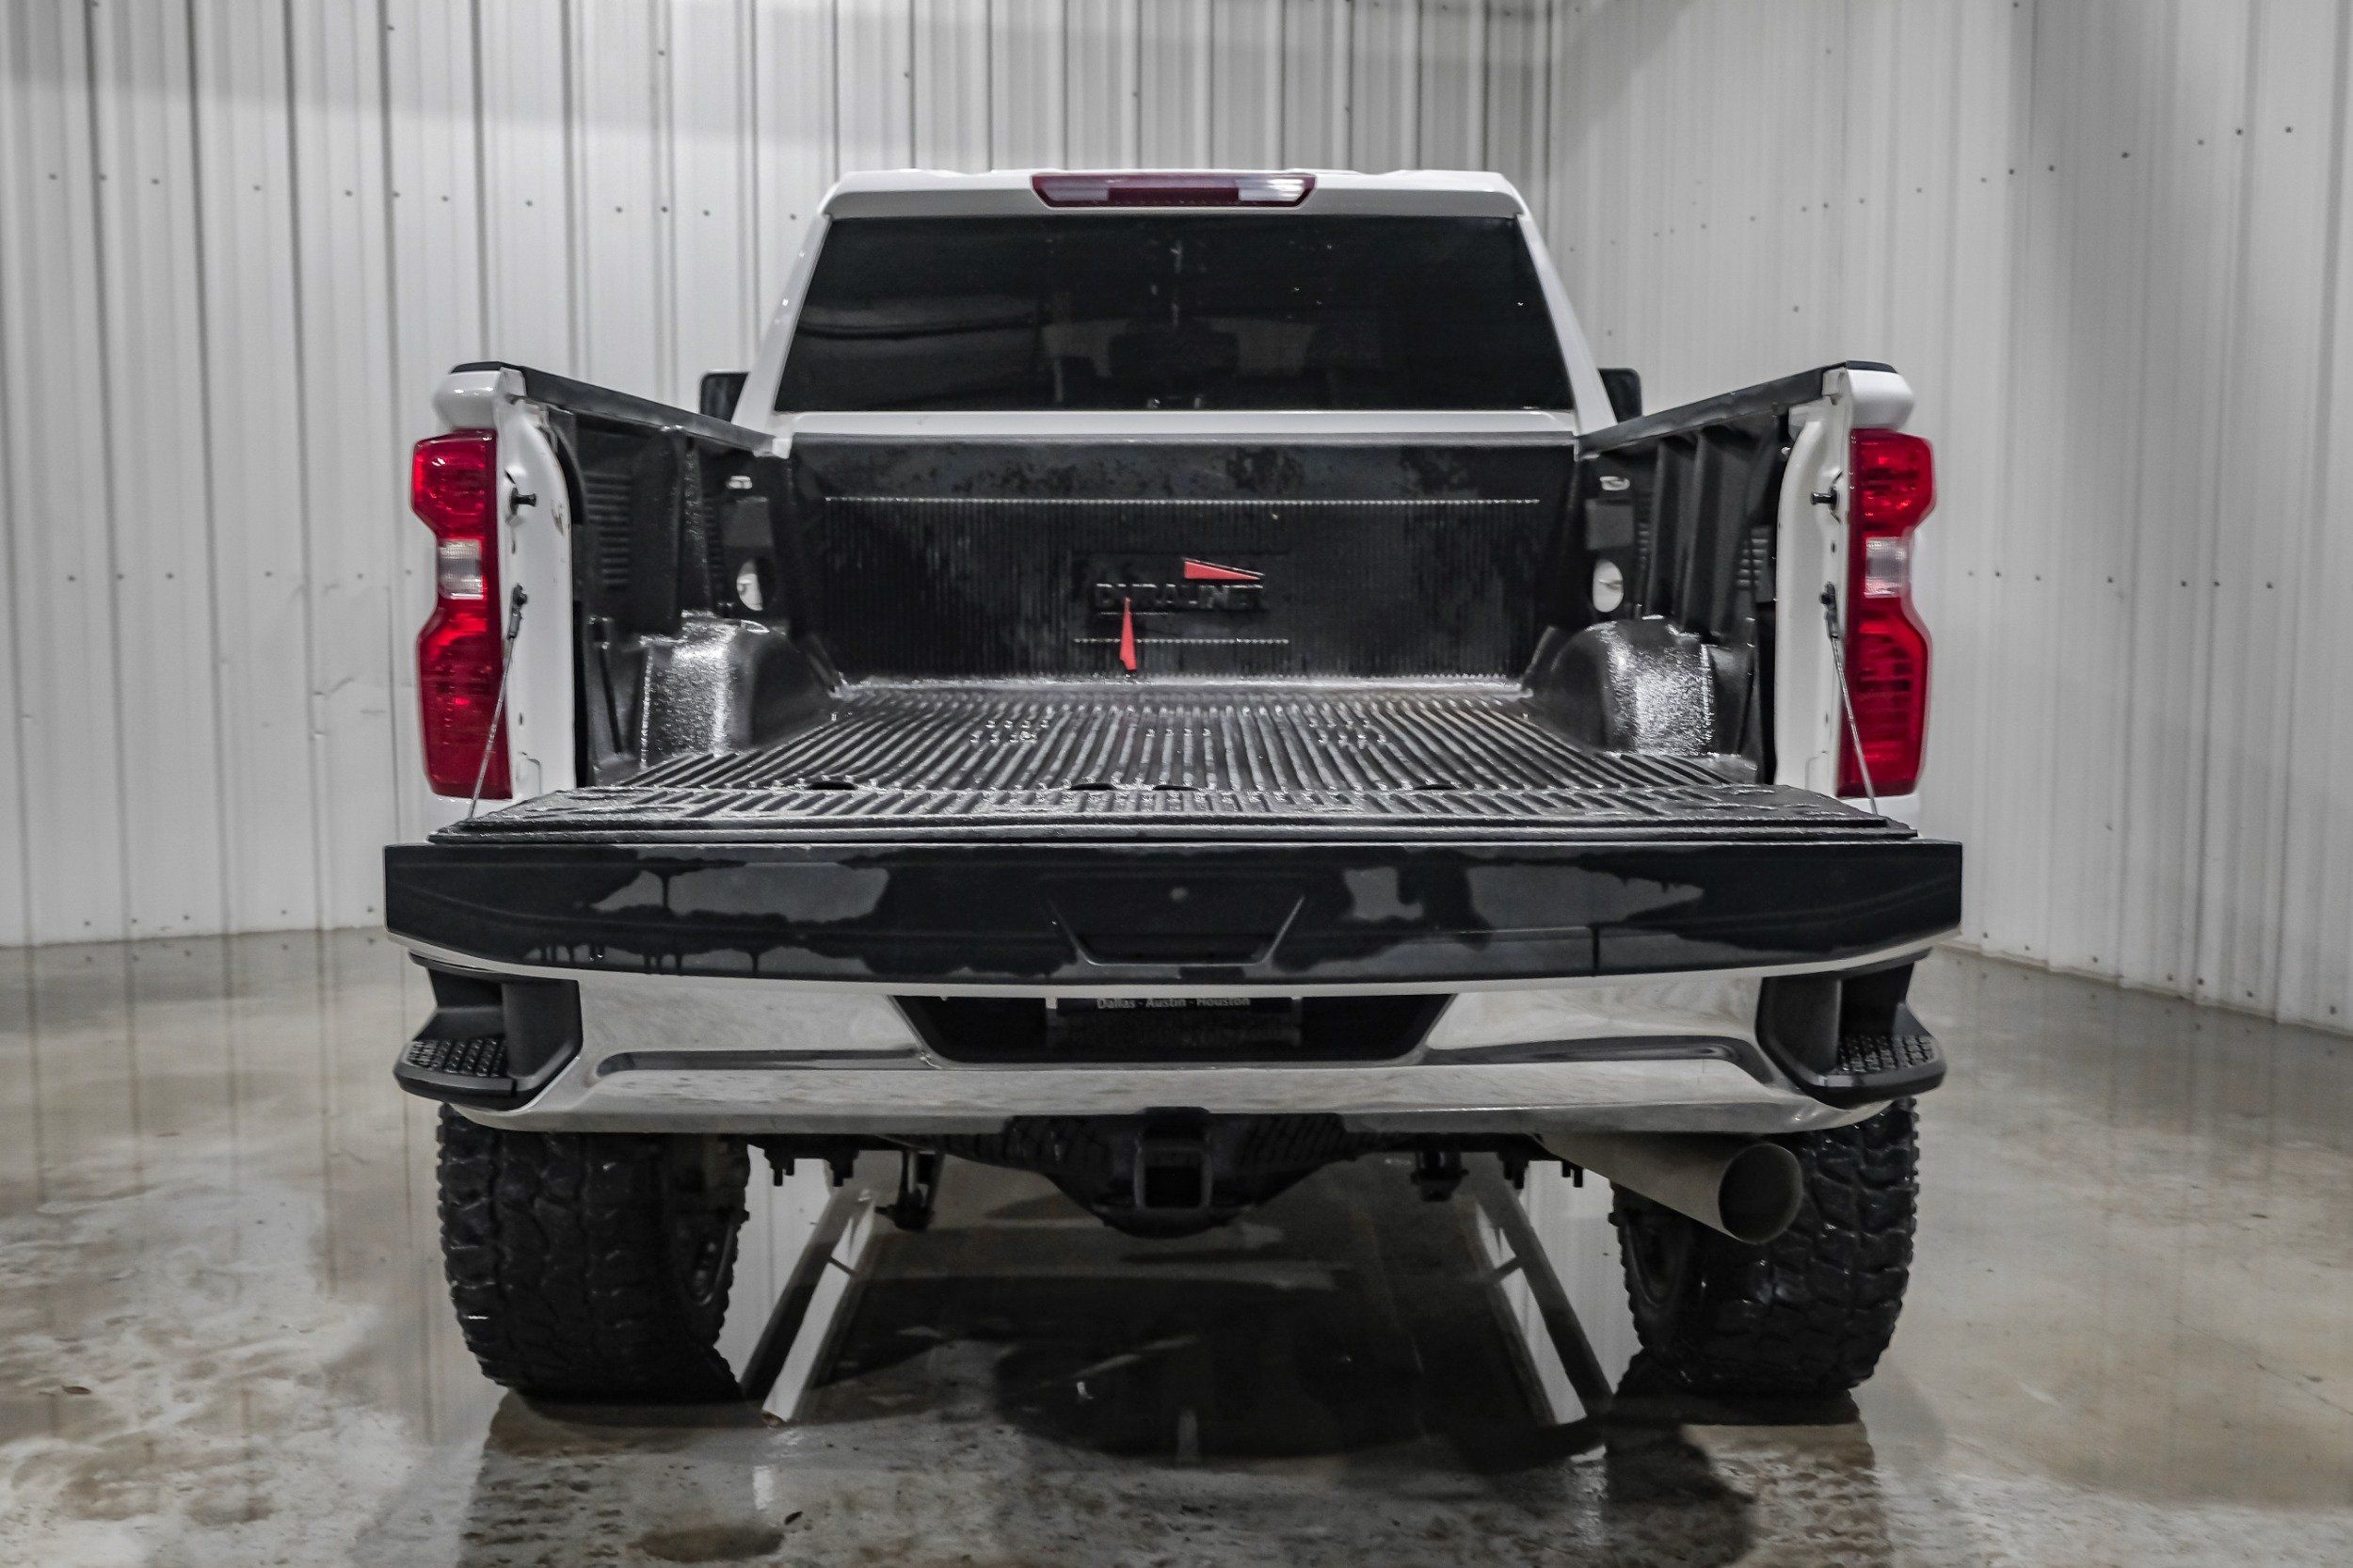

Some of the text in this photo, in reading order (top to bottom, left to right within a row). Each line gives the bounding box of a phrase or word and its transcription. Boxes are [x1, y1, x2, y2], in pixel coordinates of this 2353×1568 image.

[1096, 998, 1251, 1009] Dallas Austin Houston
